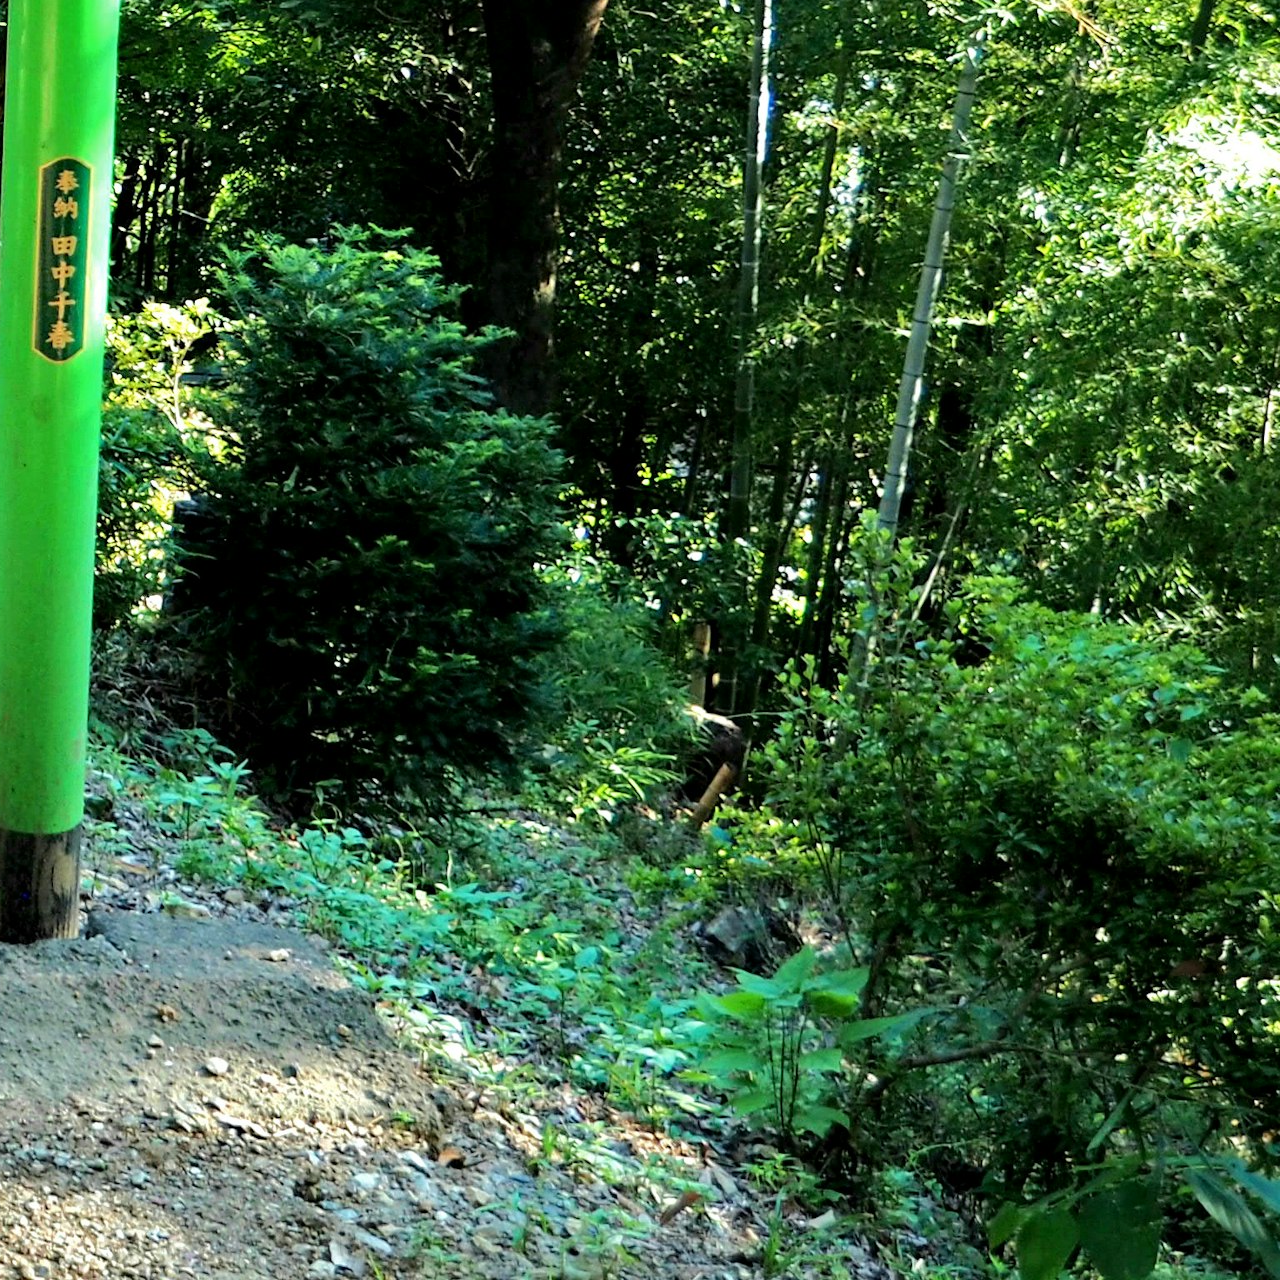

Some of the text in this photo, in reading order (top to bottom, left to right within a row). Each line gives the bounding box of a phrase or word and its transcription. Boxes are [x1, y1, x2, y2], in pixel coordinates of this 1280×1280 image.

[45, 169, 80, 349] 奉納 田中千春
